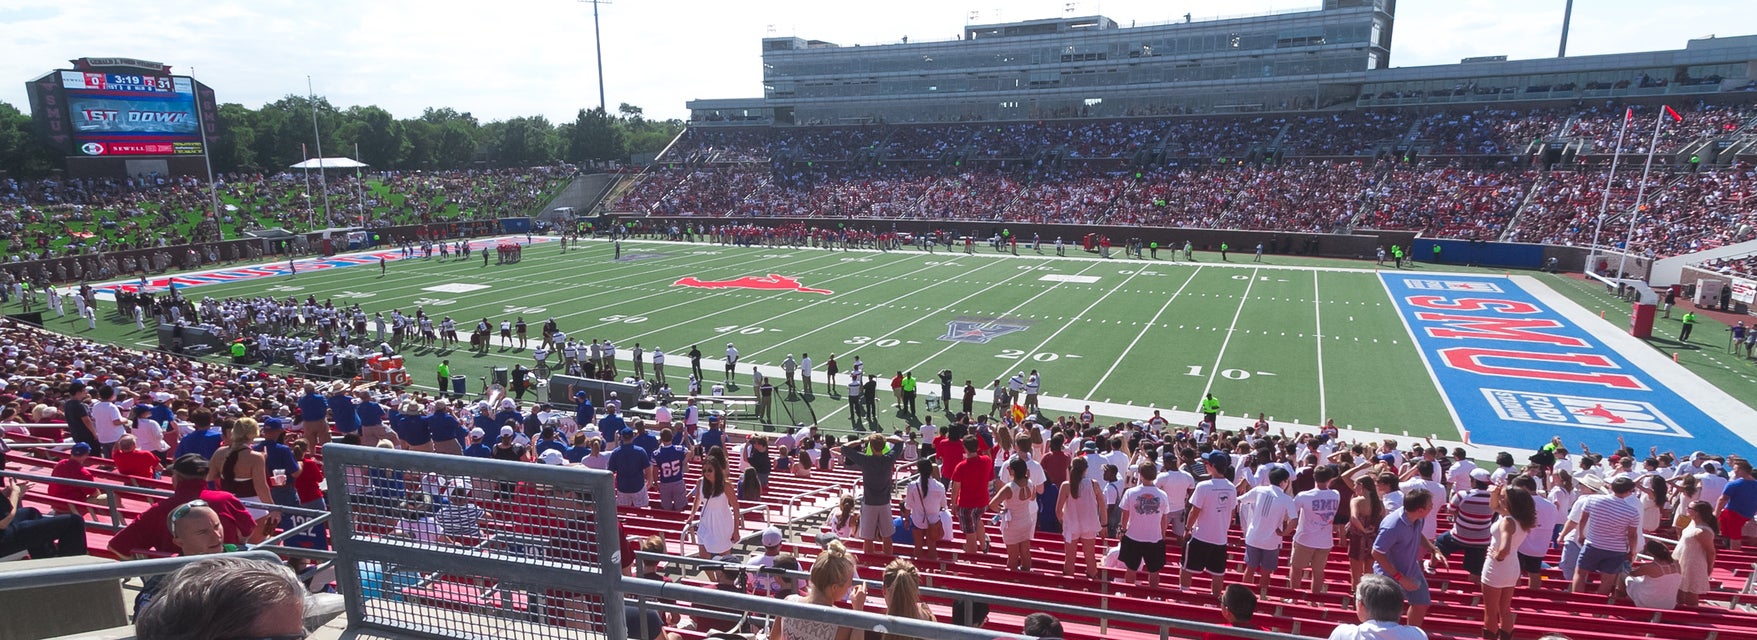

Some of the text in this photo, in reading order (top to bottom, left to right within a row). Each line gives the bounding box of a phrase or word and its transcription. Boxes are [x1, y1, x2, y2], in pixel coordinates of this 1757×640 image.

[91, 77, 99, 86] 0
[114, 75, 140, 85] 3:19
[158, 80, 170, 89] 31
[81, 109, 189, 123] 1ST DOWN
[714, 324, 765, 335] 40
[843, 335, 901, 348] 30
[1405, 294, 1652, 391] SMU
[994, 349, 1059, 362] 20
[1183, 365, 1251, 380] 10
[1521, 394, 1568, 422] FORD
[1312, 498, 1339, 512] SMU
